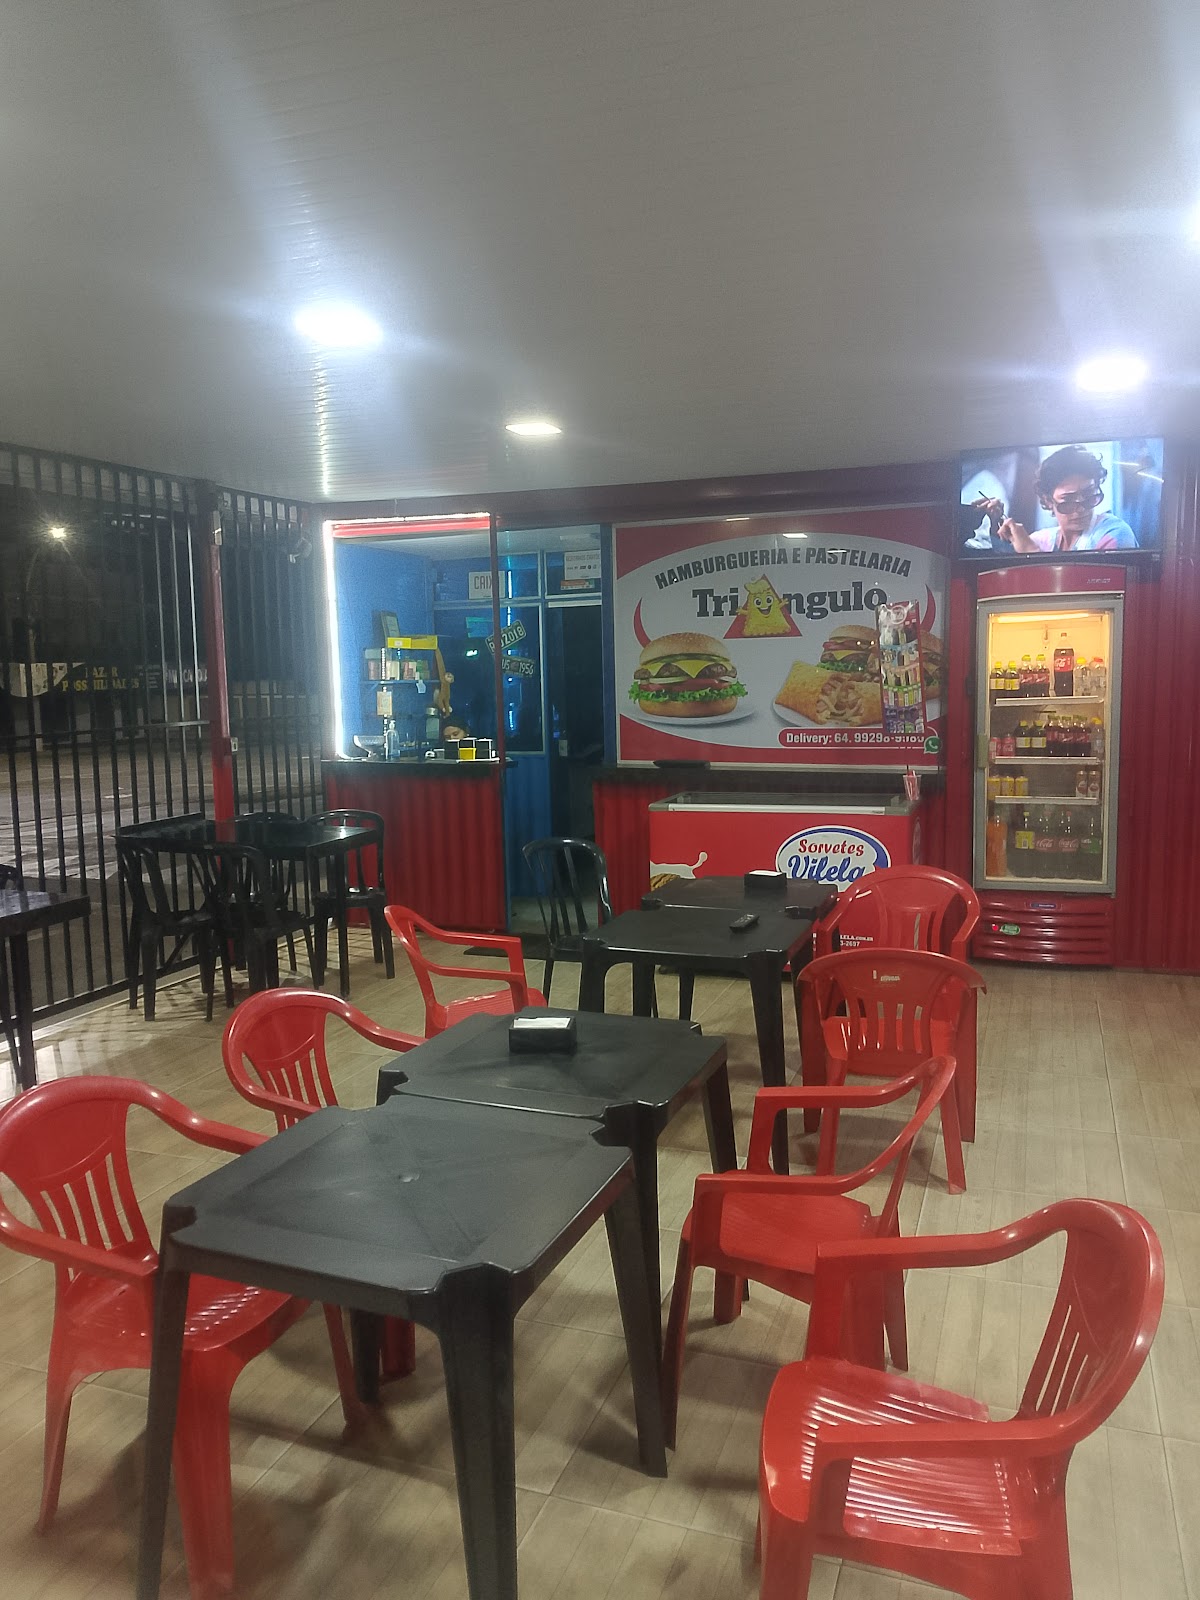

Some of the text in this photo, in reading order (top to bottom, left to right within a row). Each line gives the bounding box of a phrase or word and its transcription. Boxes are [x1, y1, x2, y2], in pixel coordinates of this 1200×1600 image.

[655, 547, 912, 590] HAMBURGUERIA E PASTELARIA
[692, 581, 887, 620] Tringulo
[519, 661, 534, 675] 1956
[786, 732, 832, 745] Delivery:
[834, 732, 852, 743] 64.
[798, 838, 864, 857] Sorvetes
[787, 854, 866, 883] Vilela
